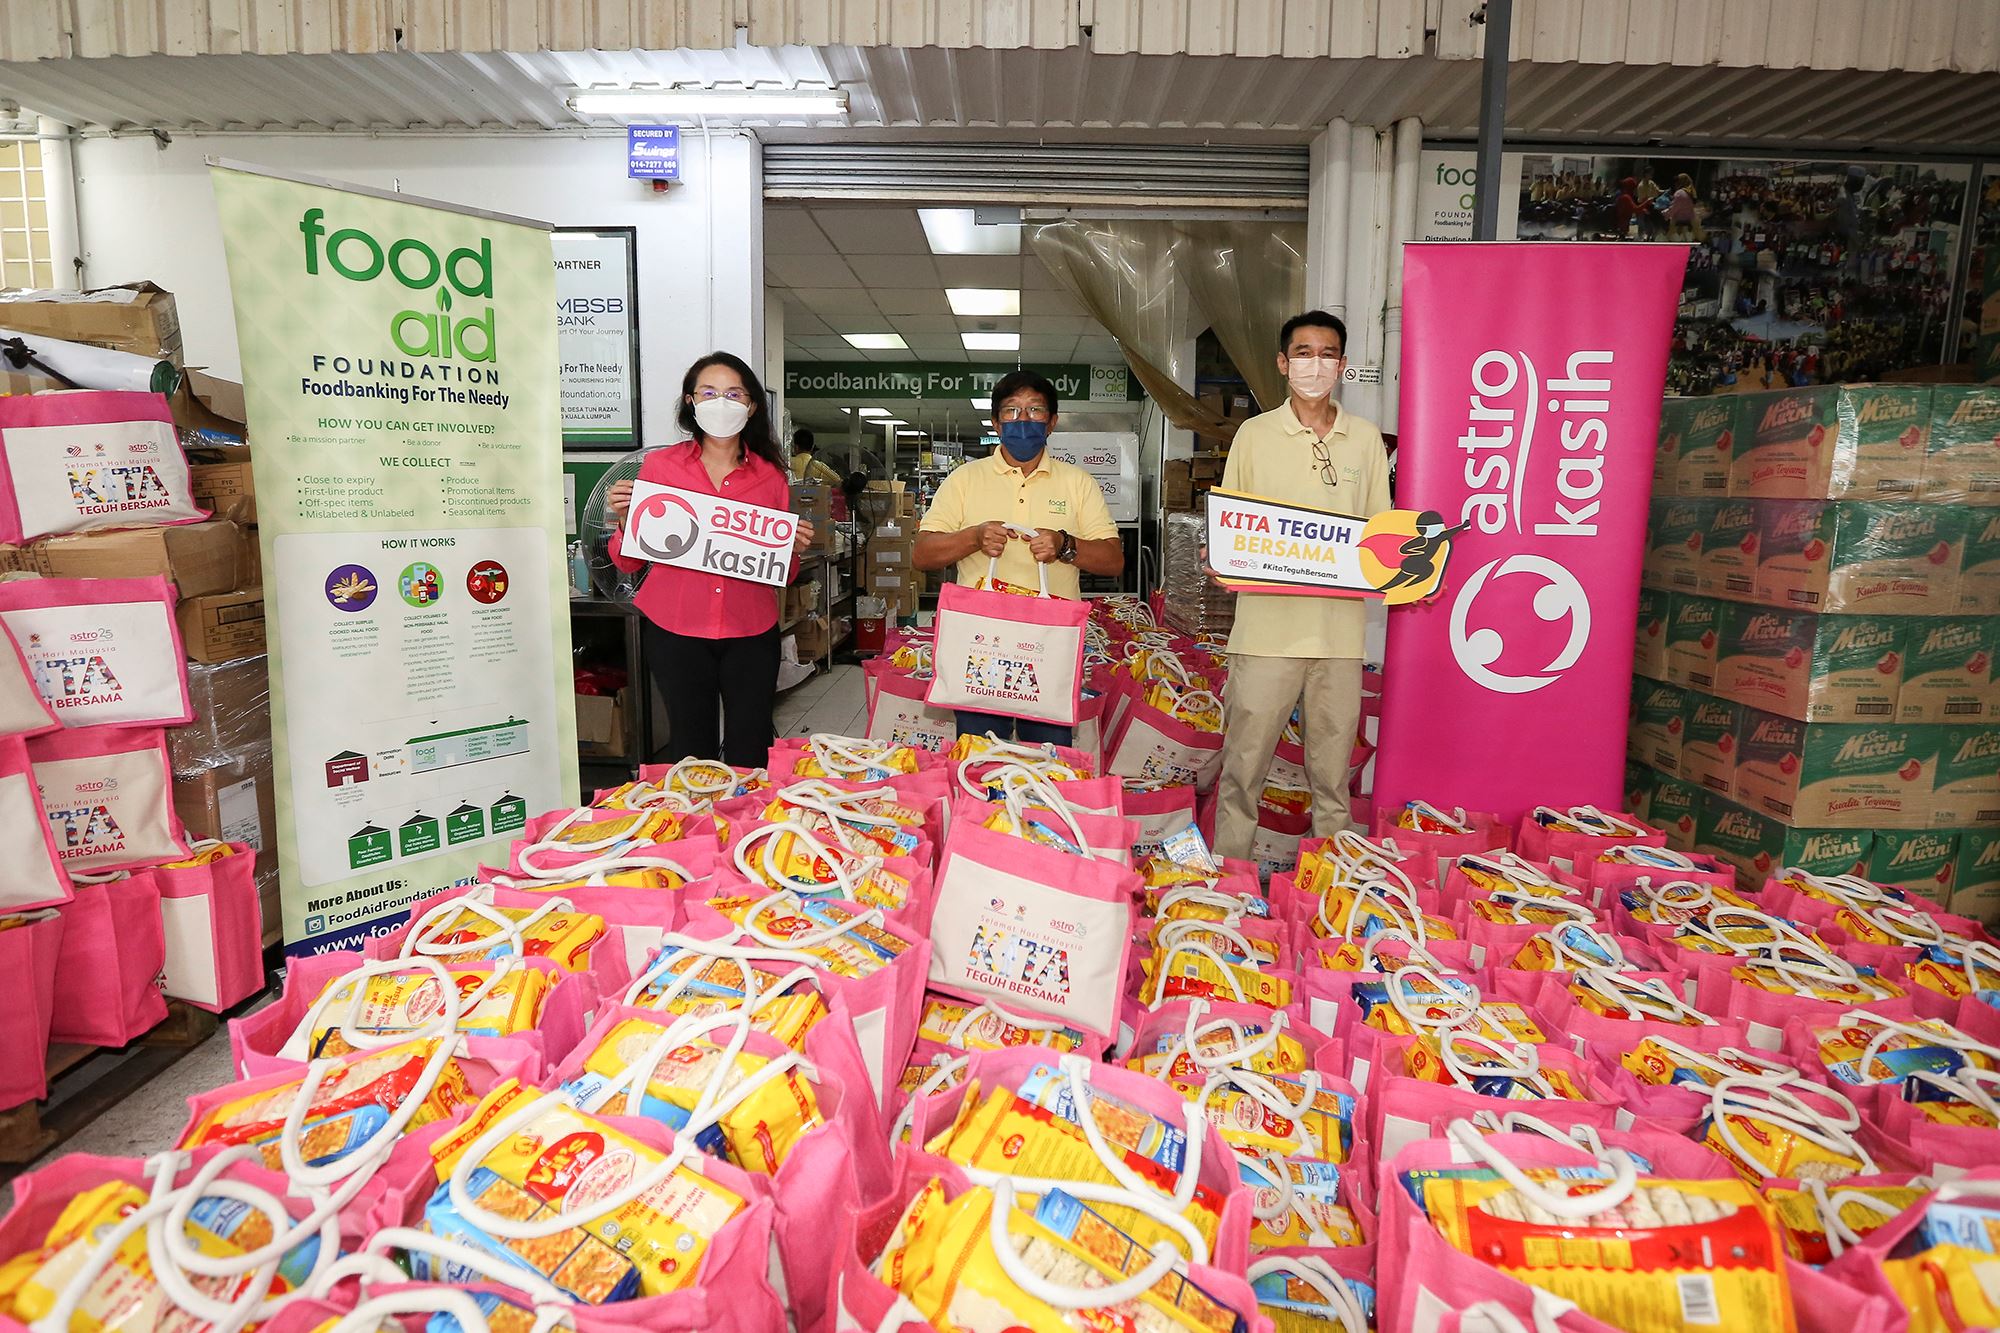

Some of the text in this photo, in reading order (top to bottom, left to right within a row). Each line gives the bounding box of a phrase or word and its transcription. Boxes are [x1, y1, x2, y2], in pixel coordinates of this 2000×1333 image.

[633, 130, 673, 138] SECURED BY
[631, 142, 677, 158] Swings
[1436, 163, 1477, 186] foo
[299, 208, 494, 298] food
[554, 260, 601, 270] ARTNER
[556, 298, 624, 314] MBSB
[390, 293, 496, 363] aid
[596, 328, 624, 336] Journey
[312, 355, 500, 385] FOUNDATION
[564, 363, 623, 375] For The Needy
[1092, 366, 1126, 380] food
[786, 371, 964, 394] Foodbanking For
[1104, 380, 1126, 393] aid
[302, 378, 510, 410] Foodbanking For The Needy
[1758, 398, 1816, 434] Murni
[1857, 398, 1918, 424] Murni
[318, 418, 495, 434] HOW YOU CAN GET INVOLVED?
[338, 437, 366, 445] partner
[1458, 350, 1518, 535] astro
[1534, 350, 1614, 536] kasih
[380, 457, 400, 467] WE
[402, 458, 451, 468] COLLECT
[68, 466, 170, 505] KITA
[304, 476, 330, 484] Close
[346, 476, 375, 486] expiry
[304, 488, 384, 496] First-line product
[500, 498, 530, 506] products
[77, 498, 170, 514] TEGUH BERSAMA
[305, 499, 346, 508] Off-spec
[448, 508, 484, 516] Seasonal
[306, 510, 358, 518] Mislabeled
[370, 510, 414, 518] Unlabeled
[710, 506, 793, 541] astro
[1220, 510, 1352, 544] KITA TEGUH
[382, 538, 456, 549] HOW IT WORKS
[1234, 534, 1336, 564] BERSAMA
[702, 539, 786, 582] kasih
[1262, 562, 1338, 580] #KitaTeguhBersama
[1741, 616, 1792, 641] Murni
[1829, 626, 1894, 654] Murni
[1920, 626, 1982, 655] Murni
[70, 646, 116, 655] Malaysia
[966, 655, 1040, 694] KITA
[56, 692, 123, 708] BERSAMA
[966, 685, 1039, 703] TEGUH BERSAMA
[1750, 720, 1798, 744] Murni
[1868, 730, 1889, 743] Seri
[416, 746, 436, 756] food
[1834, 734, 1908, 763] Murni
[74, 795, 120, 806] Malaysia
[1828, 797, 1860, 812] Kualiti
[1714, 814, 1761, 842] Murni
[1800, 836, 1862, 864] Murni
[1822, 834, 1842, 846] Seri
[1918, 835, 1938, 848] Seri
[59, 842, 125, 859] BERSAMA
[1888, 837, 1952, 867] Murni
[308, 880, 402, 912] More About Us
[328, 884, 450, 925] FoodAidFoundation
[980, 914, 1084, 952] Selamat Hari Malaysia
[968, 925, 1070, 994] KITA
[966, 967, 1066, 1006] TEGUH BERSAMA
[528, 1138, 589, 1186] Vit's
